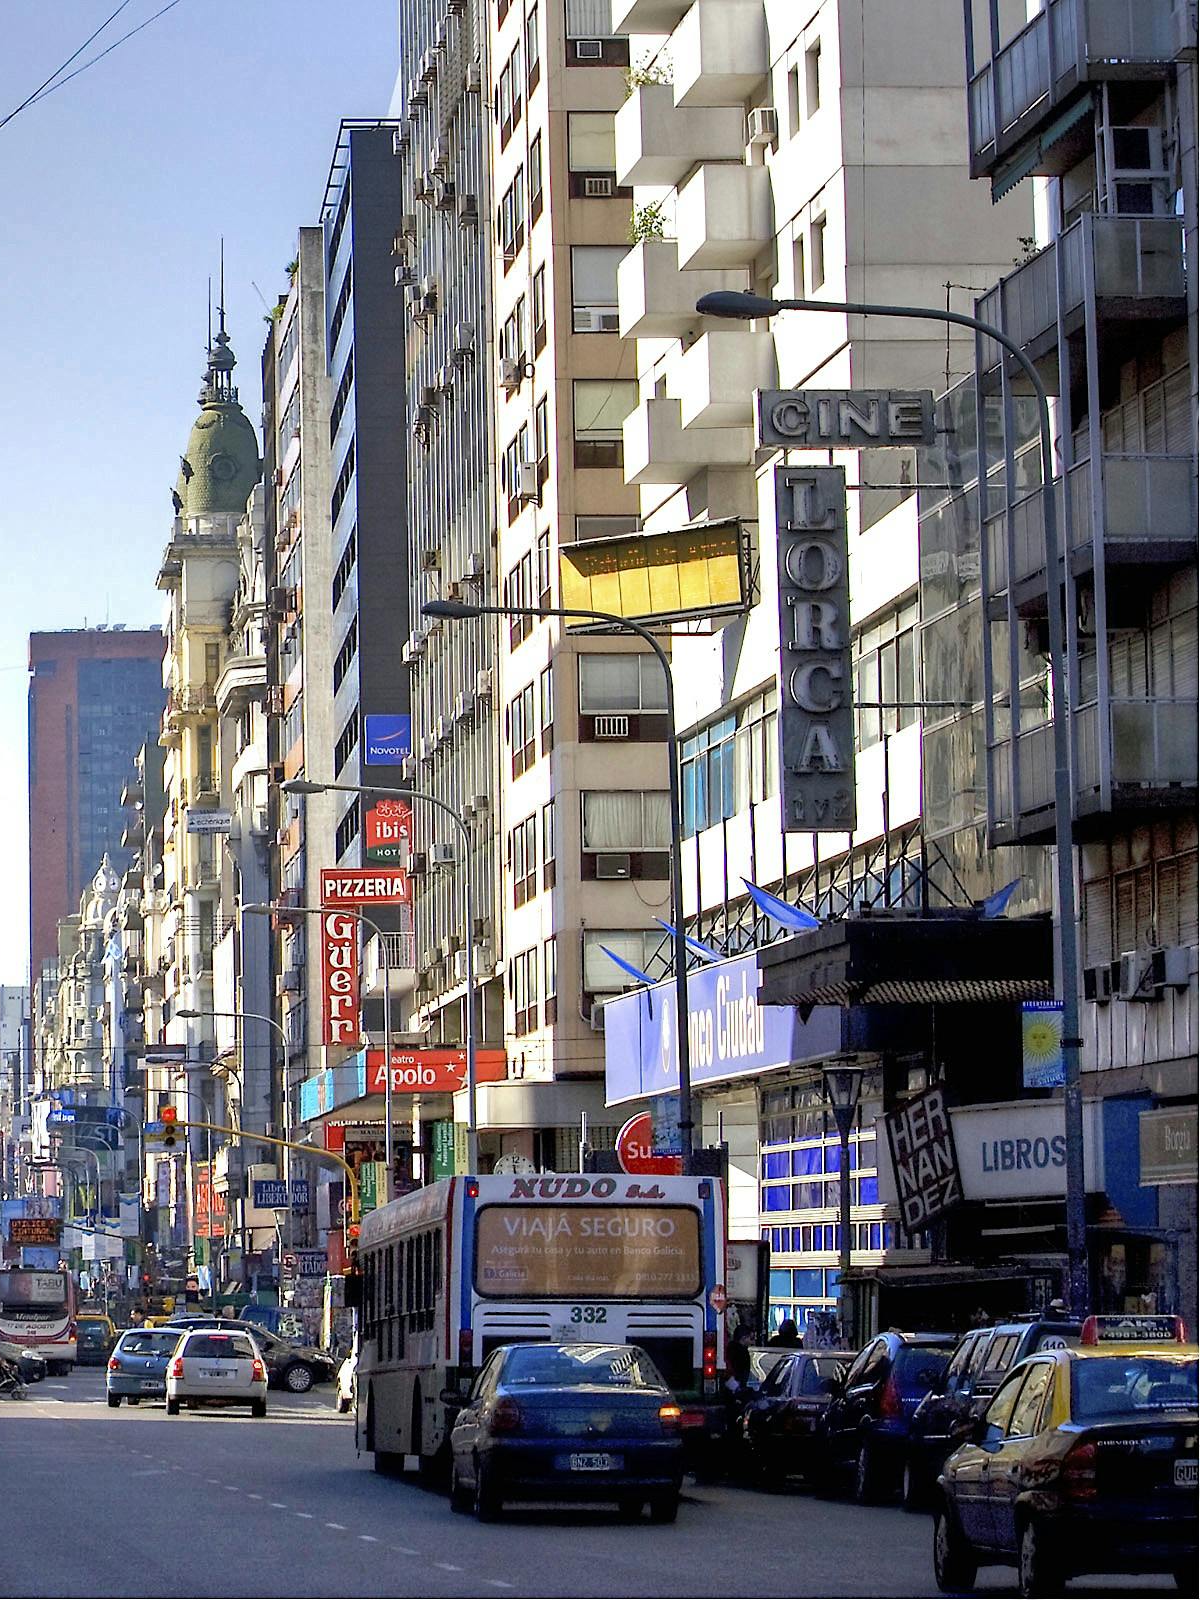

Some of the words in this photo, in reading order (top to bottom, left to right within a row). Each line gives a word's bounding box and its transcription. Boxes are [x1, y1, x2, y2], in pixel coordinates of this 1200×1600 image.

[771, 398, 922, 438] CINE
[785, 476, 844, 774] LORCA
[370, 747, 410, 755] NOVOTEL
[376, 821, 409, 838] ibis
[325, 878, 405, 897] PIZZERIA
[326, 912, 354, 1045] Güerr
[716, 970, 765, 1061] Ciudad
[391, 1055, 415, 1064] eatro
[374, 1063, 436, 1091] Apolo
[889, 1089, 947, 1160] HER
[512, 1156, 520, 1164] 12
[898, 1135, 953, 1199] NAN
[981, 1135, 1067, 1172] LIBROS
[257, 1193, 309, 1205] LIBERTDOR
[510, 1178, 617, 1199] NUDO
[904, 1173, 960, 1227] DEZ
[503, 1212, 572, 1242] VIAJÁ
[579, 1217, 676, 1238] SEGURO
[570, 1306, 607, 1324] 332
